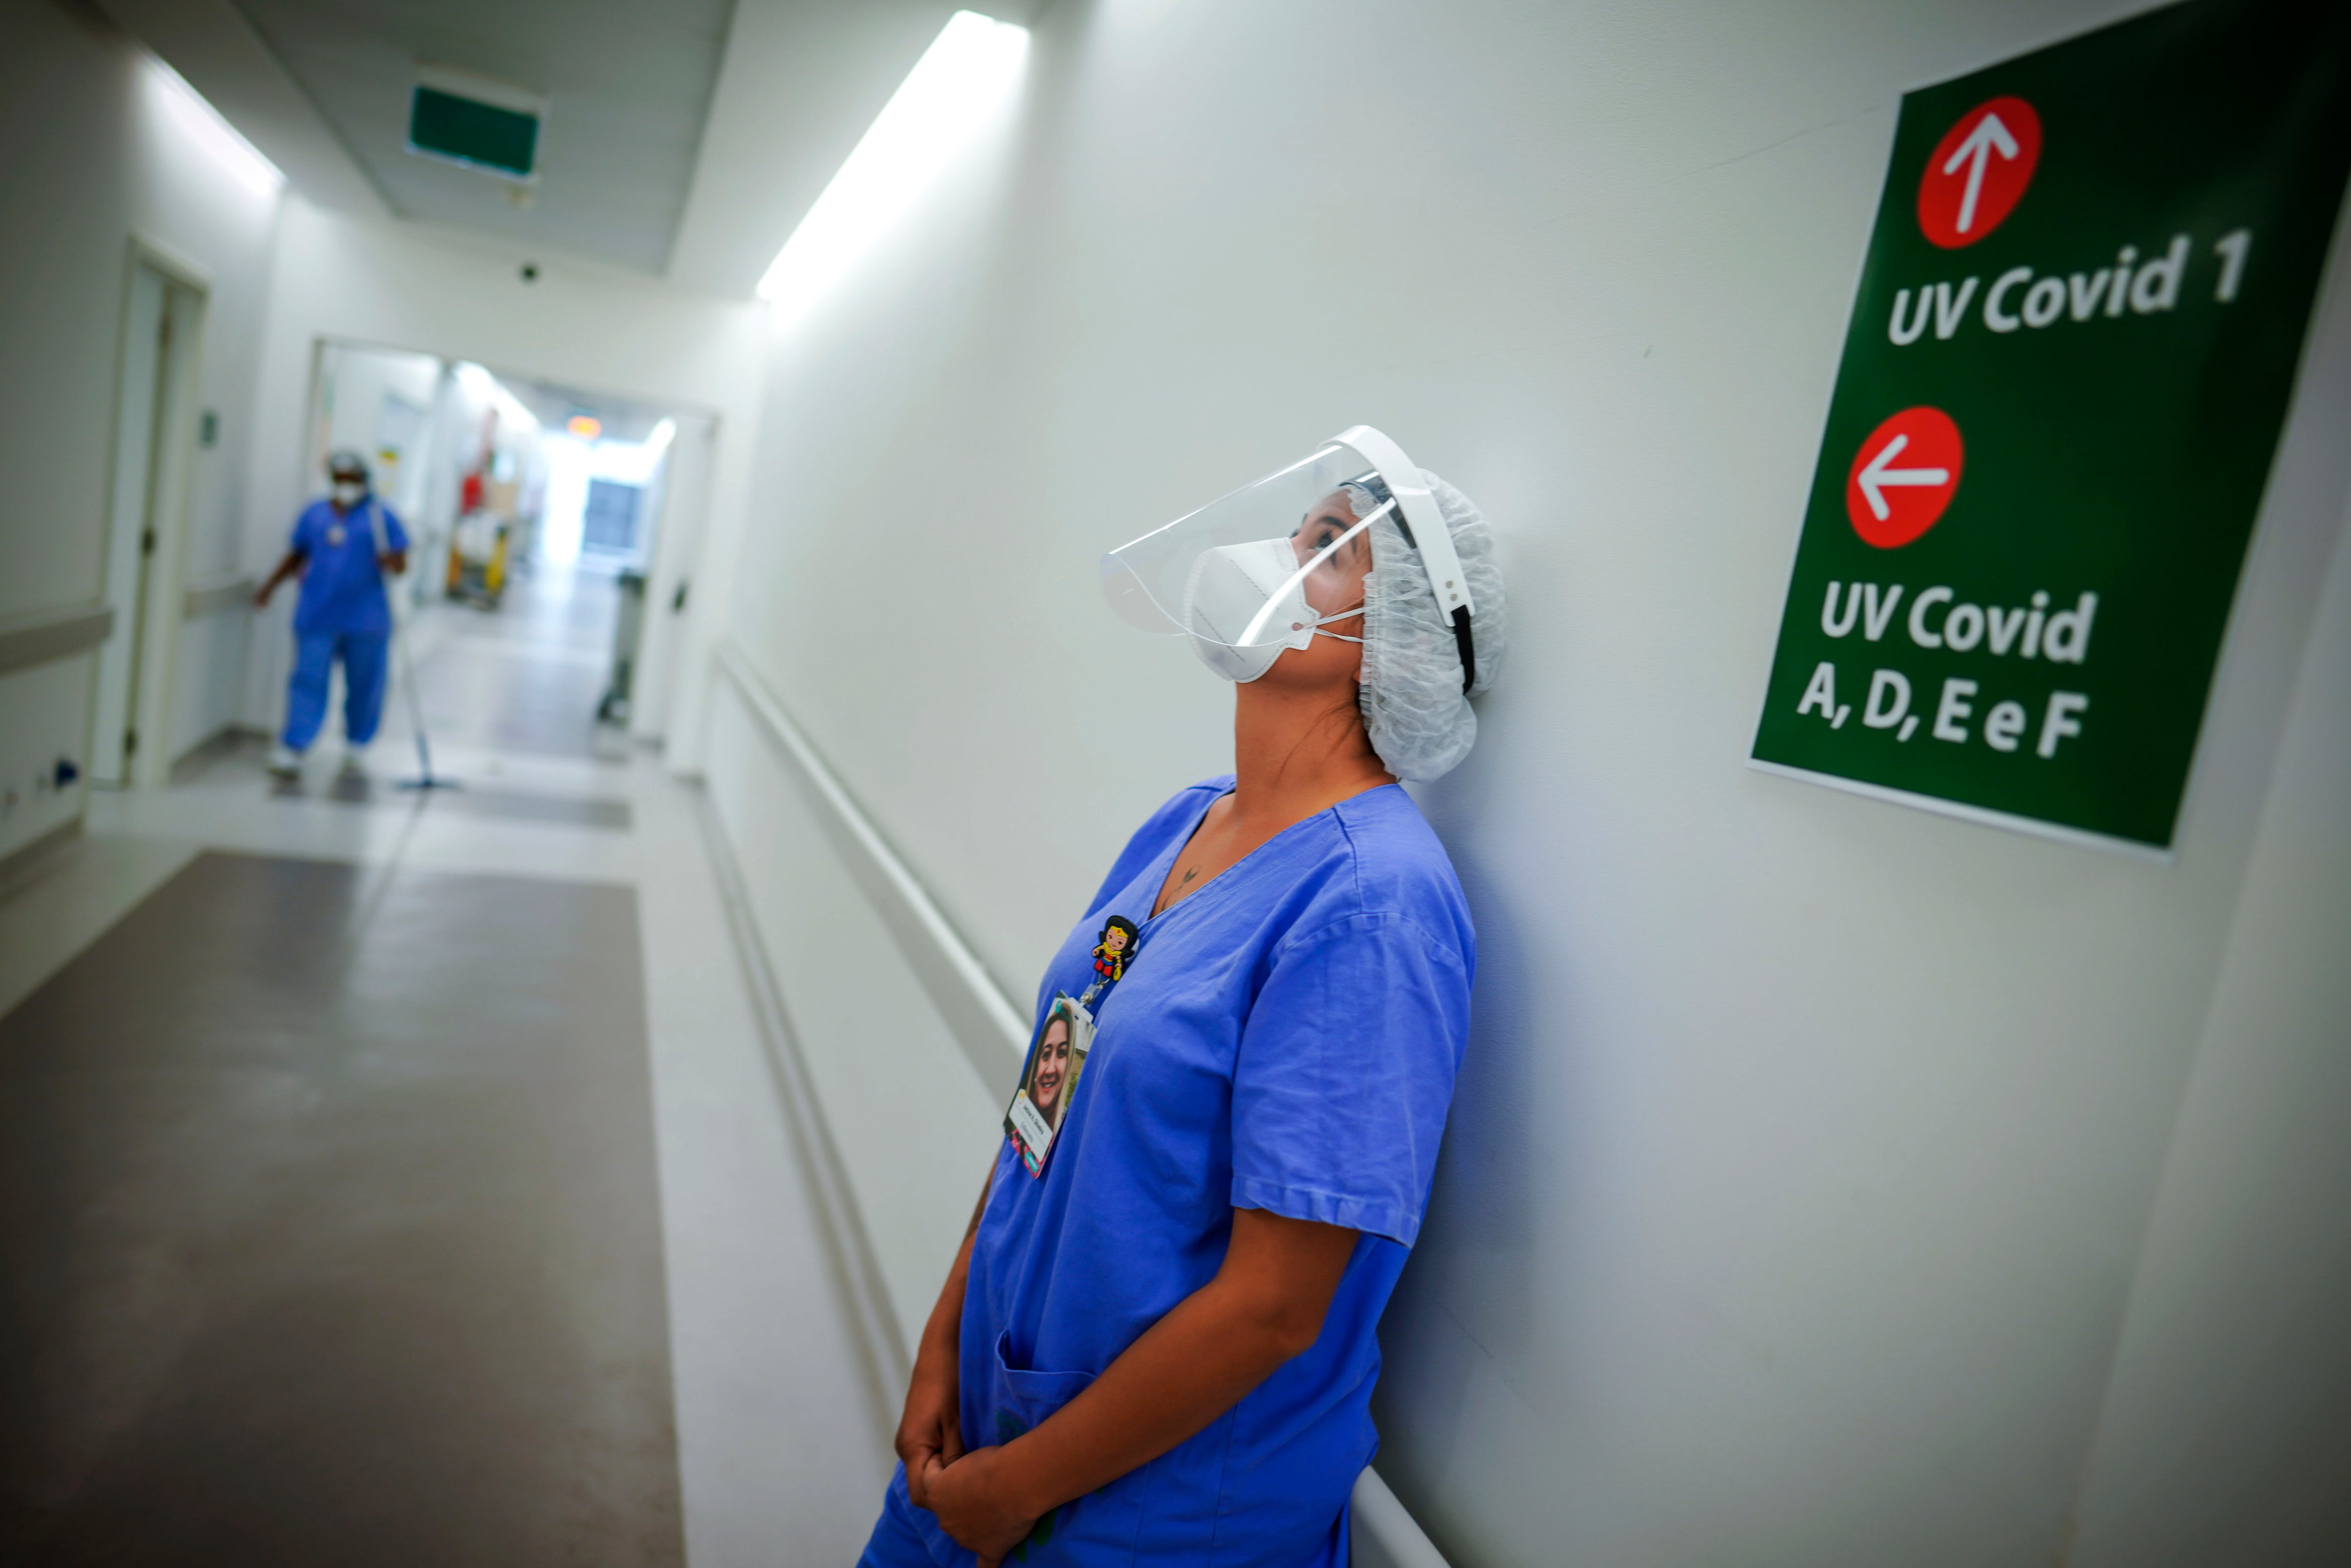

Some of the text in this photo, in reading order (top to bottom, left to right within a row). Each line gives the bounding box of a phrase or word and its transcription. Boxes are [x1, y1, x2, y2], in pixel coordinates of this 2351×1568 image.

[1888, 229, 2251, 347] UV Covid 1
[1820, 580, 2098, 663] UV Covid
[1796, 661, 2088, 758] A, D, E e F
